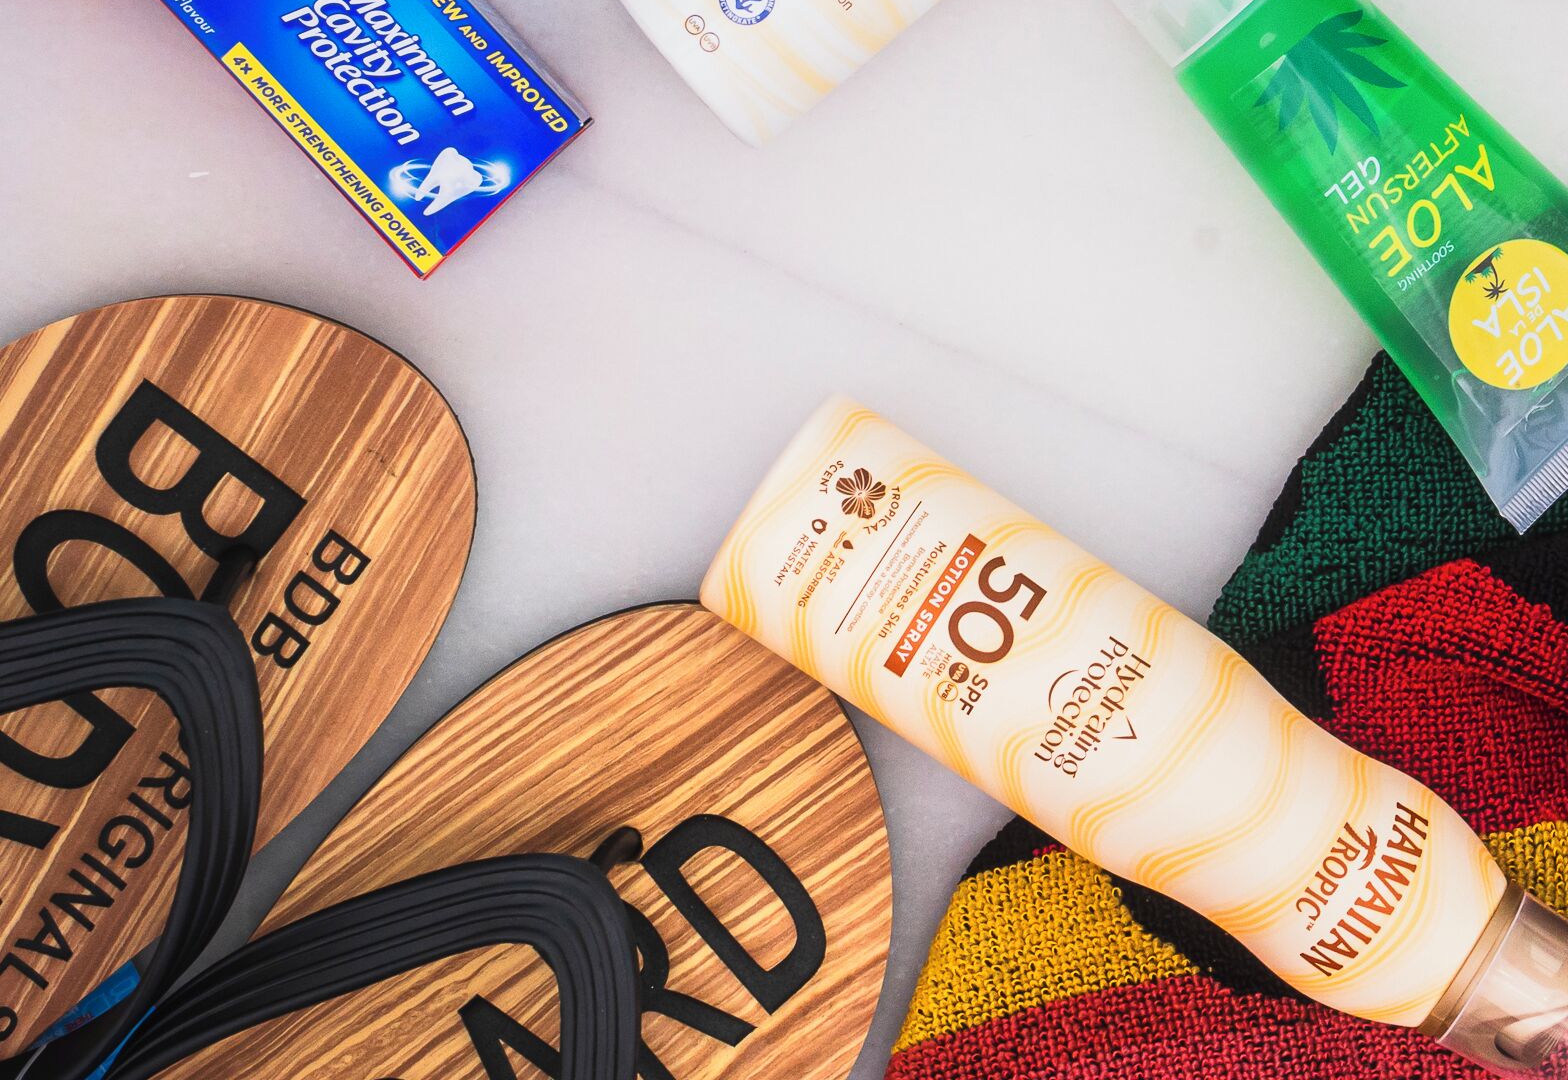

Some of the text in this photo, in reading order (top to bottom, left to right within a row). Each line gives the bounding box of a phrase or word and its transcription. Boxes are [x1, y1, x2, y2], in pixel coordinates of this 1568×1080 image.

[282, 6, 420, 155] Protection
[459, 18, 488, 50] AND
[485, 50, 569, 133] IMPROVED
[251, 76, 290, 113] MORE
[286, 113, 384, 213] STRENGTHENING
[1324, 156, 1381, 204] GEL
[1346, 114, 1472, 233] AFTERSUN
[1369, 144, 1495, 277] ALOE
[1397, 241, 1454, 291] SOOTHING
[1472, 267, 1551, 338] ISLA
[1508, 303, 1544, 336] DE LA
[819, 460, 844, 494] SCENT
[863, 485, 900, 535] TROPICAL
[241, 528, 371, 670] BDB
[774, 534, 809, 586] RESISTANT
[792, 541, 818, 575] WATER
[797, 552, 835, 611] ABSORBING
[826, 554, 845, 583] FAST
[876, 541, 947, 638] Moisturises Skin
[896, 543, 975, 662] LOTION SPRAY
[948, 556, 1048, 663] 50
[932, 653, 952, 676] HIGH
[959, 674, 988, 716] SPF
[1034, 636, 1129, 766] Protection
[1054, 647, 1151, 778] Hydrating
[0, 728, 193, 991] RIGINAL
[1299, 802, 1429, 977] HAWAIIAN
